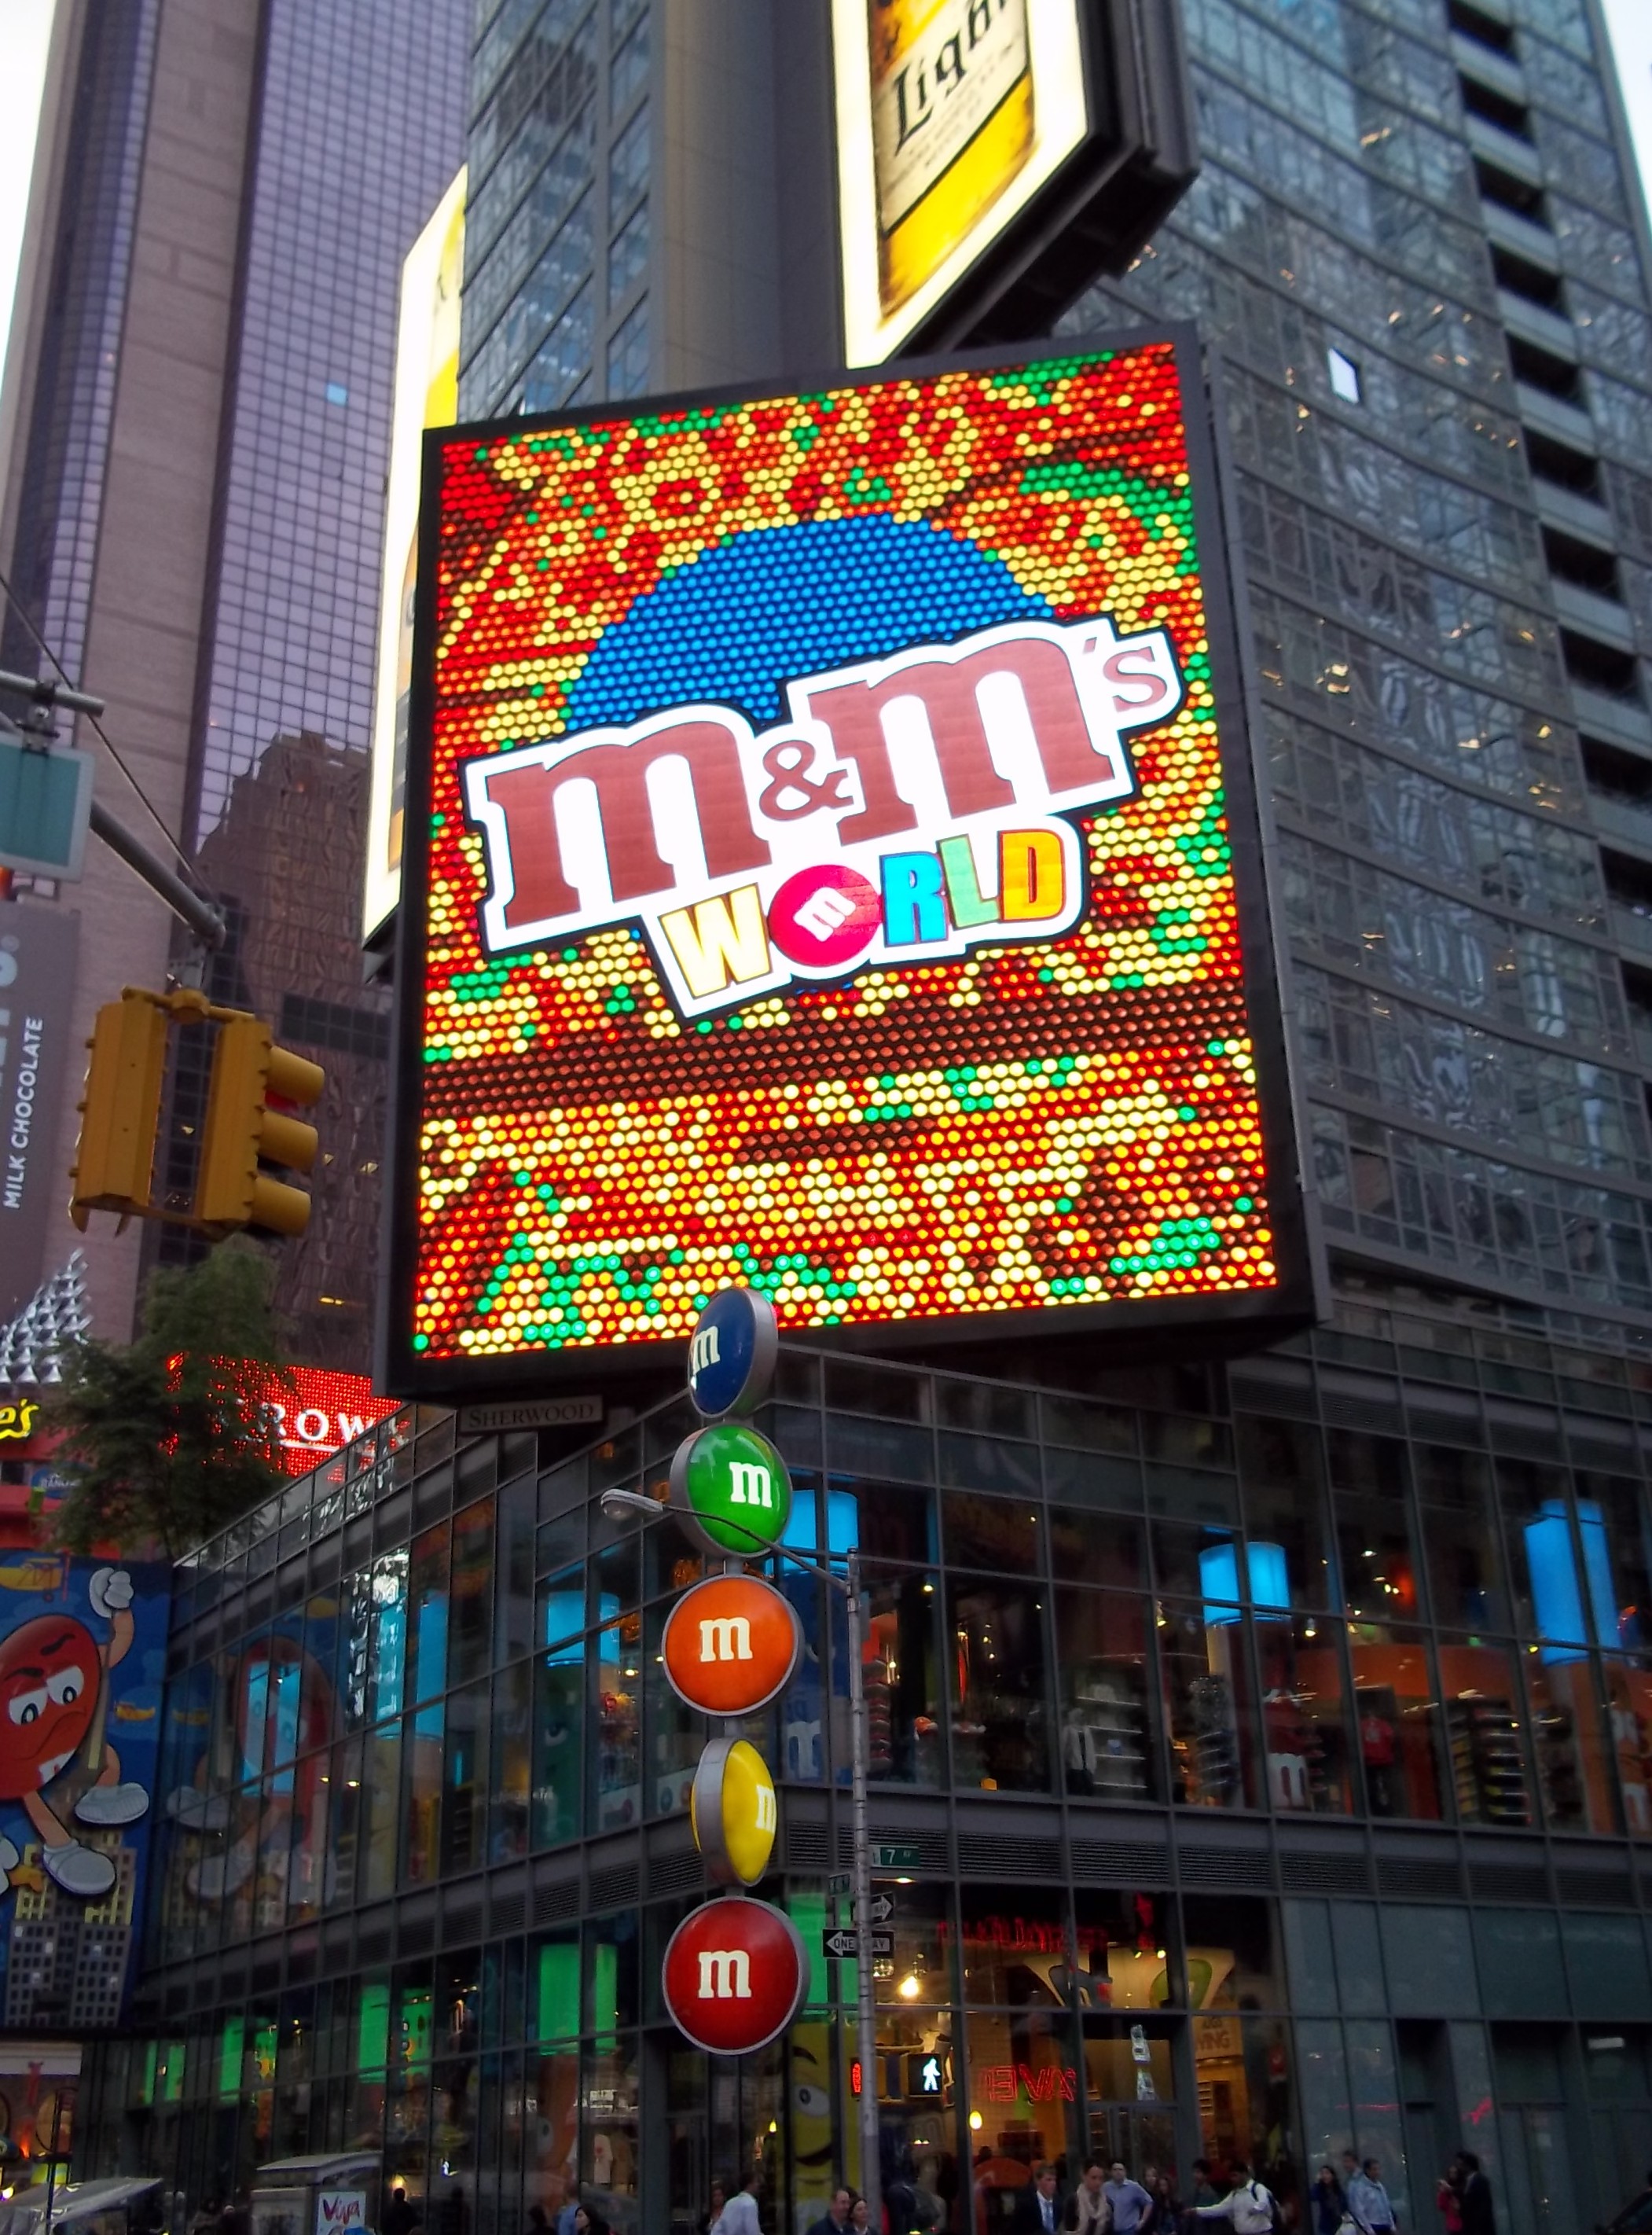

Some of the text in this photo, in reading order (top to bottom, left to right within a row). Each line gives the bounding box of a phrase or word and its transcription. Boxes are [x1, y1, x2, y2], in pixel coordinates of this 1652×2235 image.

[892, 0, 1007, 157] Ligh
[2, 1016, 43, 1210] MILK CHOCOLATE
[469, 1404, 593, 1428] SHERWOOD
[729, 1461, 773, 1509] m
[699, 1616, 753, 1663] m
[887, 1849, 897, 1864] 7
[834, 1938, 854, 1949] ONE
[697, 1950, 752, 1998] m
